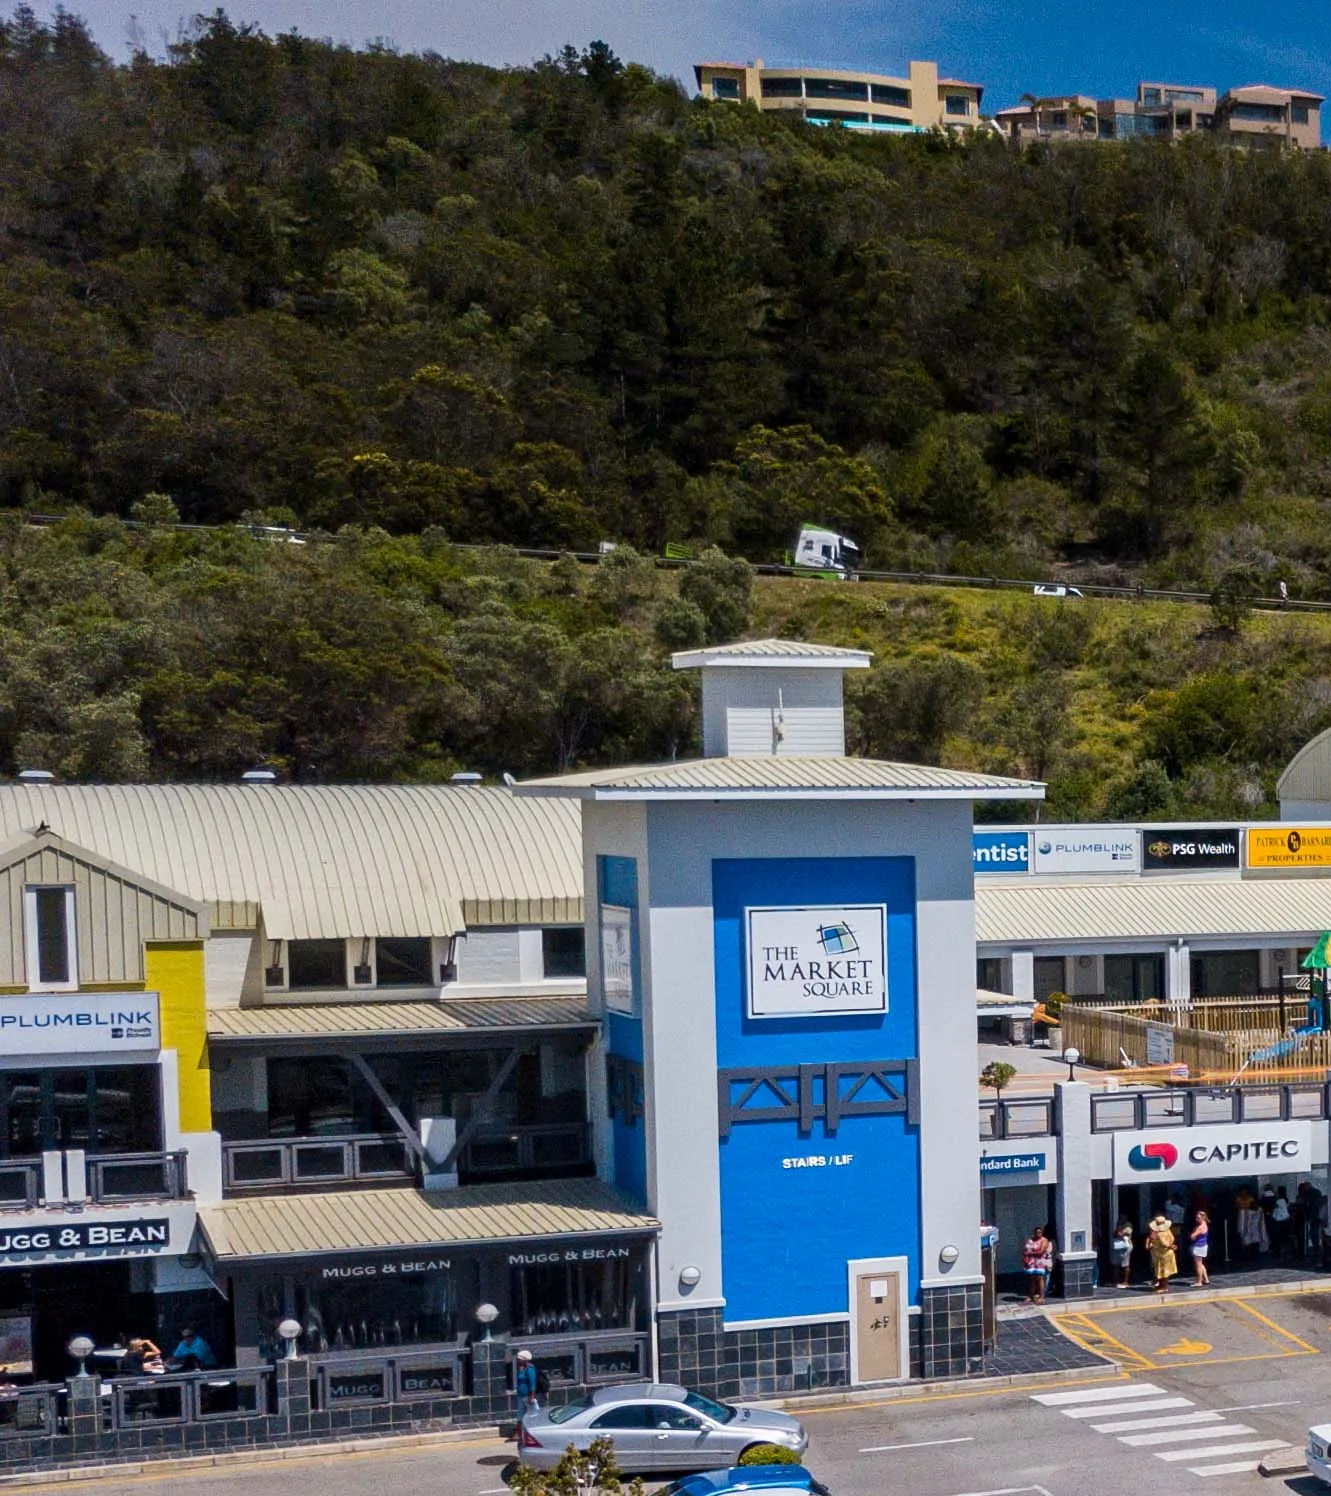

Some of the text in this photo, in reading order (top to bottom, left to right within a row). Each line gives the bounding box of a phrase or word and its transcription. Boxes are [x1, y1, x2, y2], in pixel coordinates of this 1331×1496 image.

[973, 843, 1029, 862] ntist
[1056, 841, 1134, 853] PLUMBLINK
[1172, 842, 1235, 856] PSG Wealth
[1266, 854, 1323, 863] PROPERTIES
[762, 946, 799, 961] THE
[764, 960, 873, 981] MARKET
[802, 981, 873, 999] SQUARE
[1, 1011, 152, 1028] PLUMBLINK
[1188, 1140, 1299, 1164] CAPITEC
[782, 1155, 827, 1169] STAIRS
[980, 1156, 1040, 1171] ndard Bank
[59, 1228, 81, 1247] &
[88, 1225, 166, 1245] BEAN
[508, 1248, 630, 1265] MUGG & BEAN
[322, 1259, 451, 1279] MUGG & BEAN
[404, 1377, 450, 1391] BEAN
